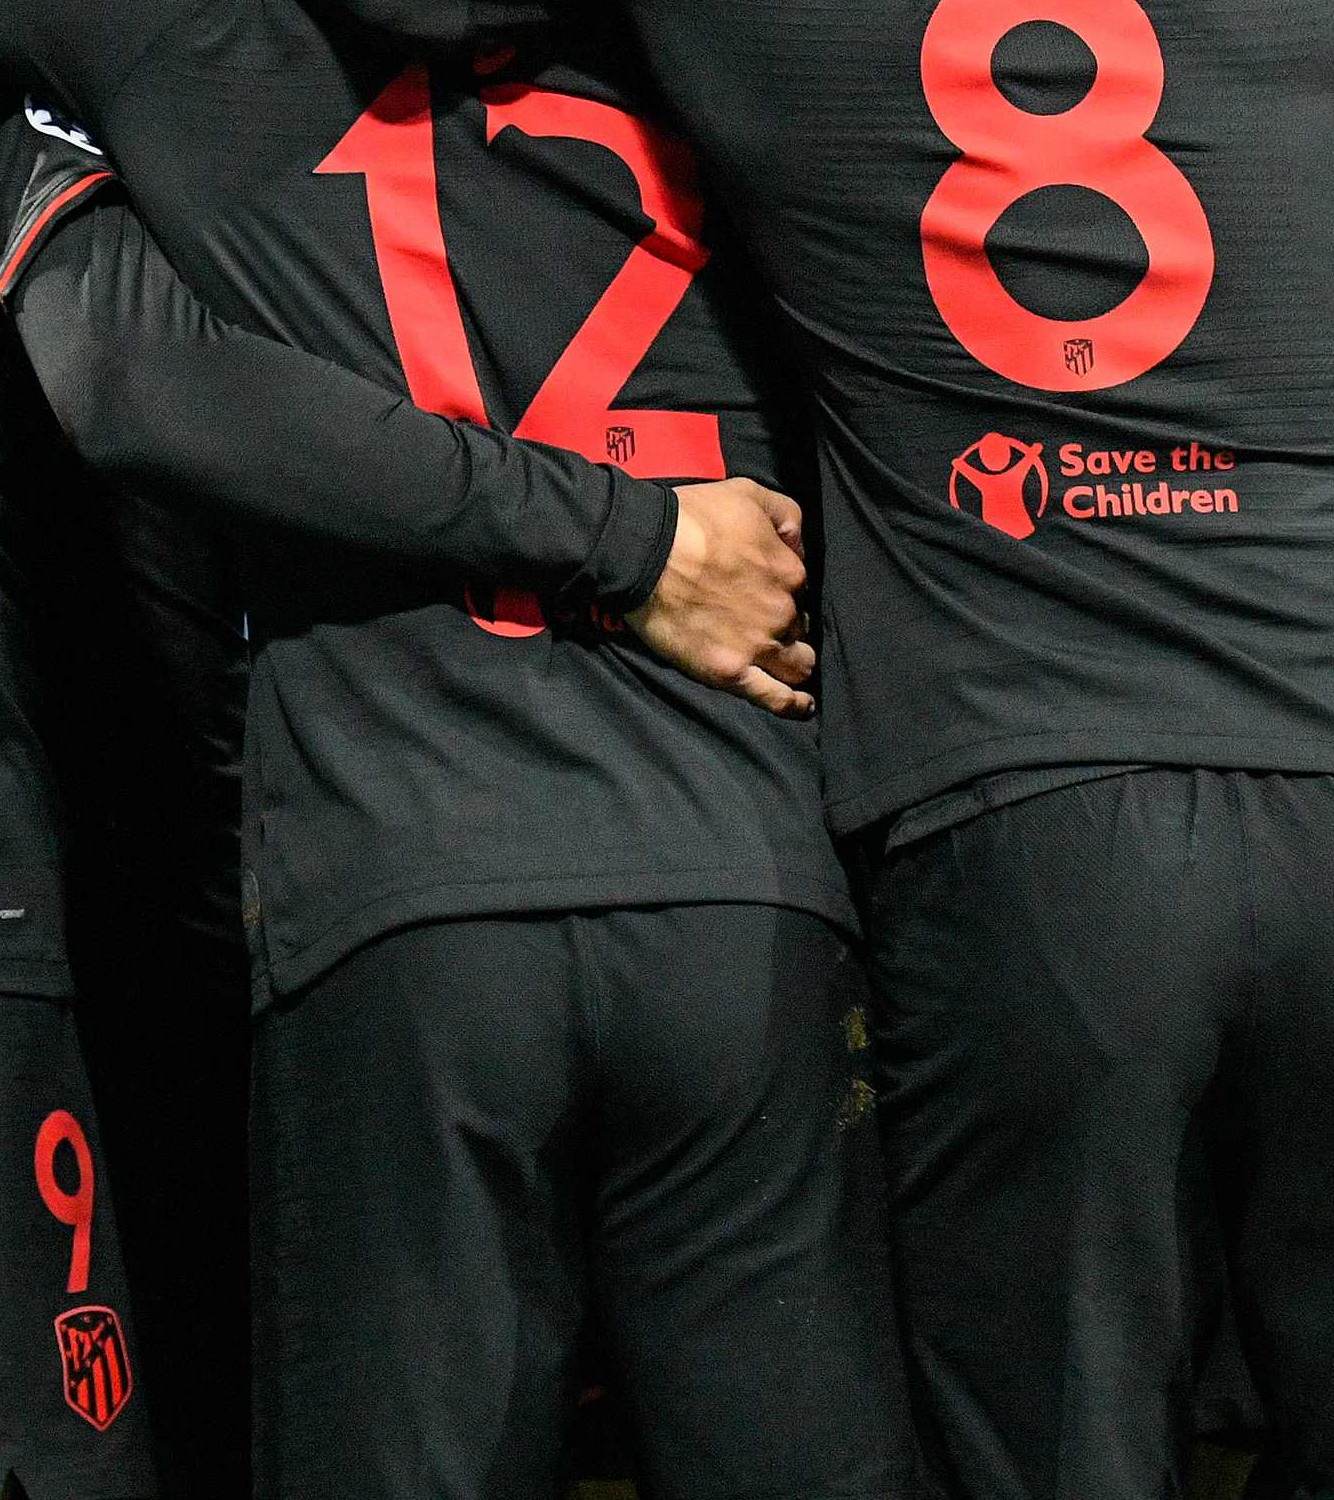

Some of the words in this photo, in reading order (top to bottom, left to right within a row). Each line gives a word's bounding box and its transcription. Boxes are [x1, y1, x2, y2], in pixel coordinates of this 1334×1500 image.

[312, 60, 727, 482] 12
[1058, 442, 1157, 477] Save
[1170, 442, 1236, 472] the
[1062, 481, 1240, 520] Children
[33, 1109, 95, 1294] 9
